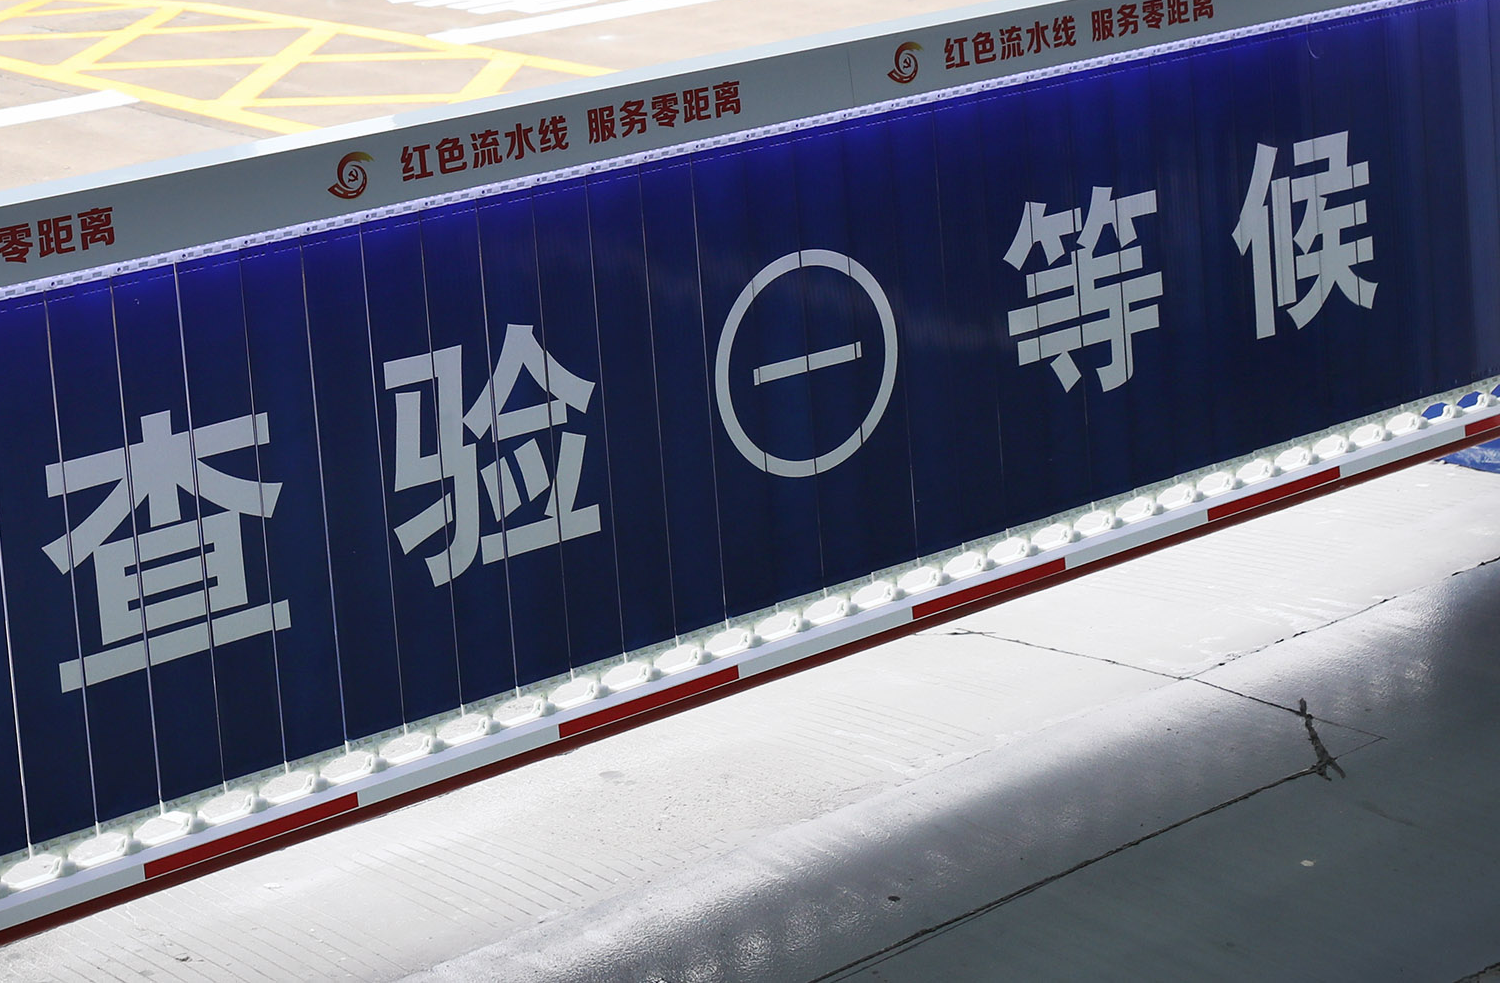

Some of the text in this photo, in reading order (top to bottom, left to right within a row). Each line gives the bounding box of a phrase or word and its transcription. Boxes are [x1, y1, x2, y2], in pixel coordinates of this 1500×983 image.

[943, 16, 1077, 70] 红色流水线
[400, 80, 743, 183] 红色流水线 服务零距离
